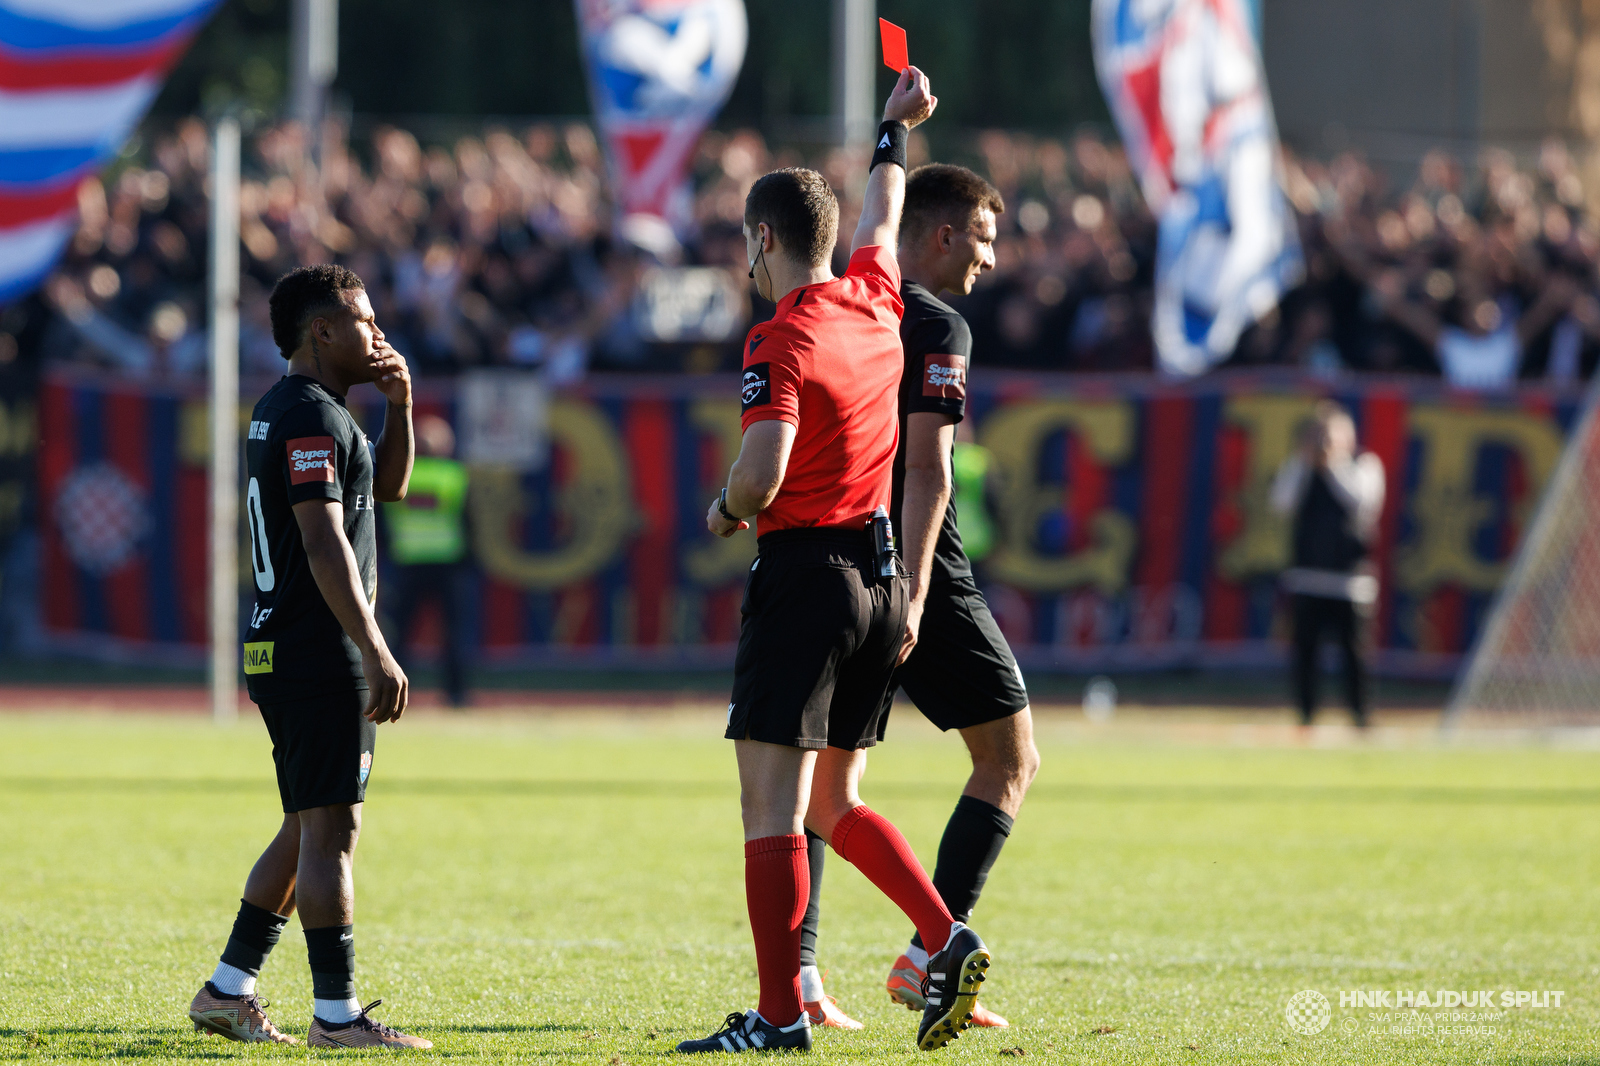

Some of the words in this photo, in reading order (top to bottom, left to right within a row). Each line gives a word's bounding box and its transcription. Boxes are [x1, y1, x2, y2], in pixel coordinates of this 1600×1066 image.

[927, 363, 963, 376] Super
[291, 449, 331, 461] Super
[294, 459, 330, 471] Sport
[247, 477, 275, 592] 0
[244, 649, 270, 667] NIA
